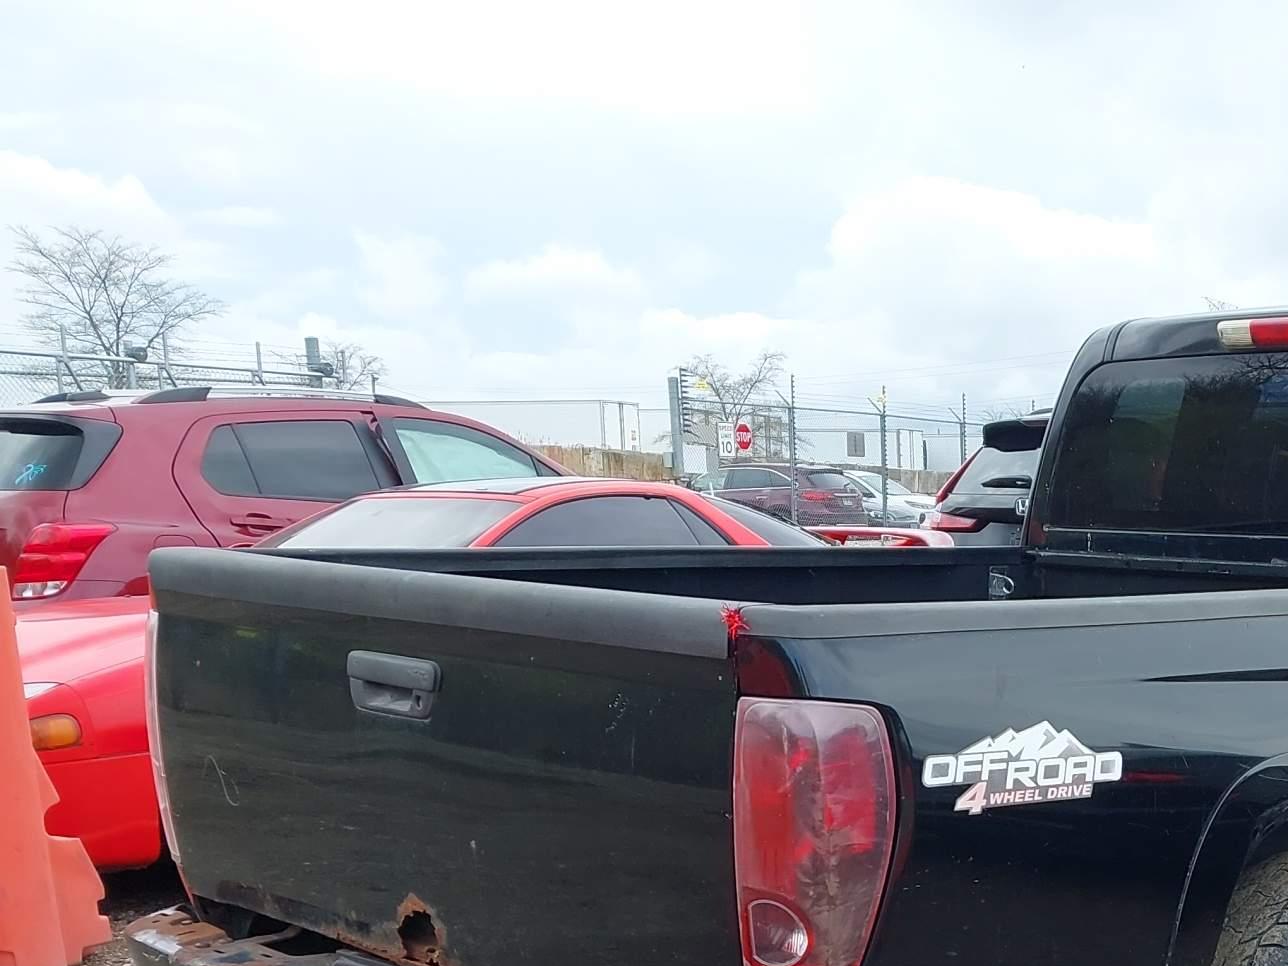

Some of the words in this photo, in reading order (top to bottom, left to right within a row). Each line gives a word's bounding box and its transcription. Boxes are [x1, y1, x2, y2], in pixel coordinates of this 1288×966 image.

[736, 432, 751, 443] STOP
[721, 441, 733, 454] 10
[954, 781, 988, 816] 4
[989, 788, 1042, 805] WHEEL
[1047, 783, 1092, 800] DRIVE
